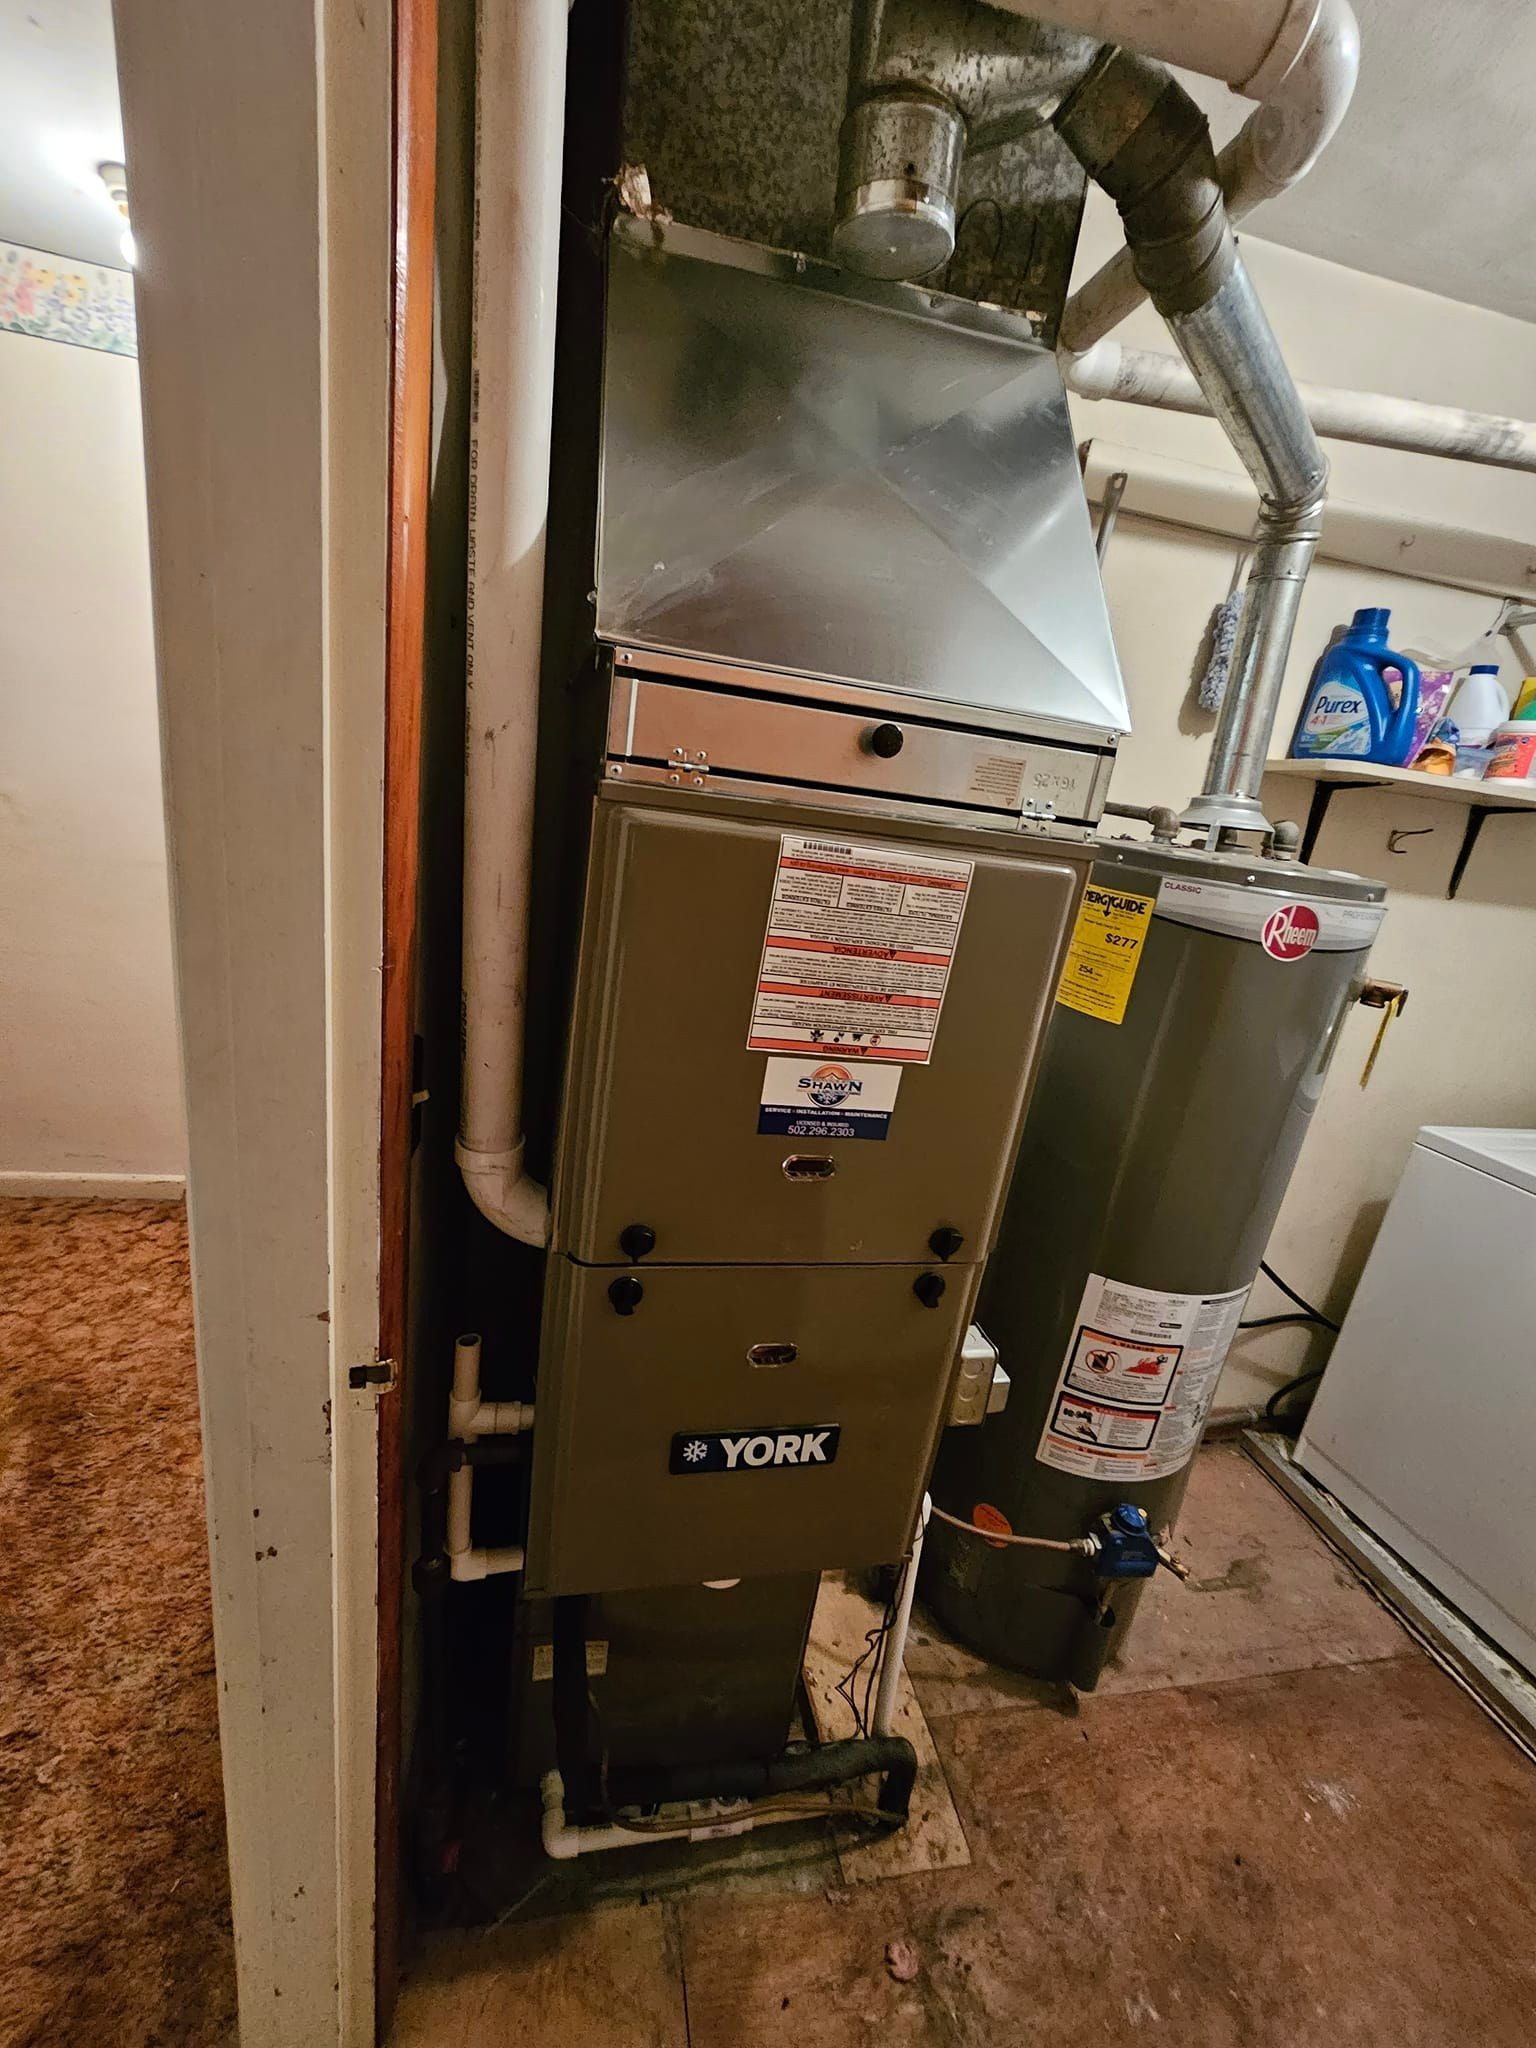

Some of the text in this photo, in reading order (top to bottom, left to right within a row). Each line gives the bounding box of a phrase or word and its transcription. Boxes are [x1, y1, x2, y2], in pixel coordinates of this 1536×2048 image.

[466, 613, 475, 650] VENT
[1314, 696, 1362, 714] Purex
[1164, 881, 1202, 894] CLASSIC
[1266, 906, 1316, 951] Rheem
[1105, 933, 1138, 949] $277
[832, 945, 889, 958] ADVERTENCIA
[819, 989, 884, 1002] AVERTISSEMENT
[821, 1045, 859, 1054] WARNING
[796, 1108, 841, 1117] INSTALLATION
[845, 1111, 888, 1119] MAINTENANCE
[787, 1125, 855, 1137] 502.296.2303
[720, 1432, 830, 1467] YORK
